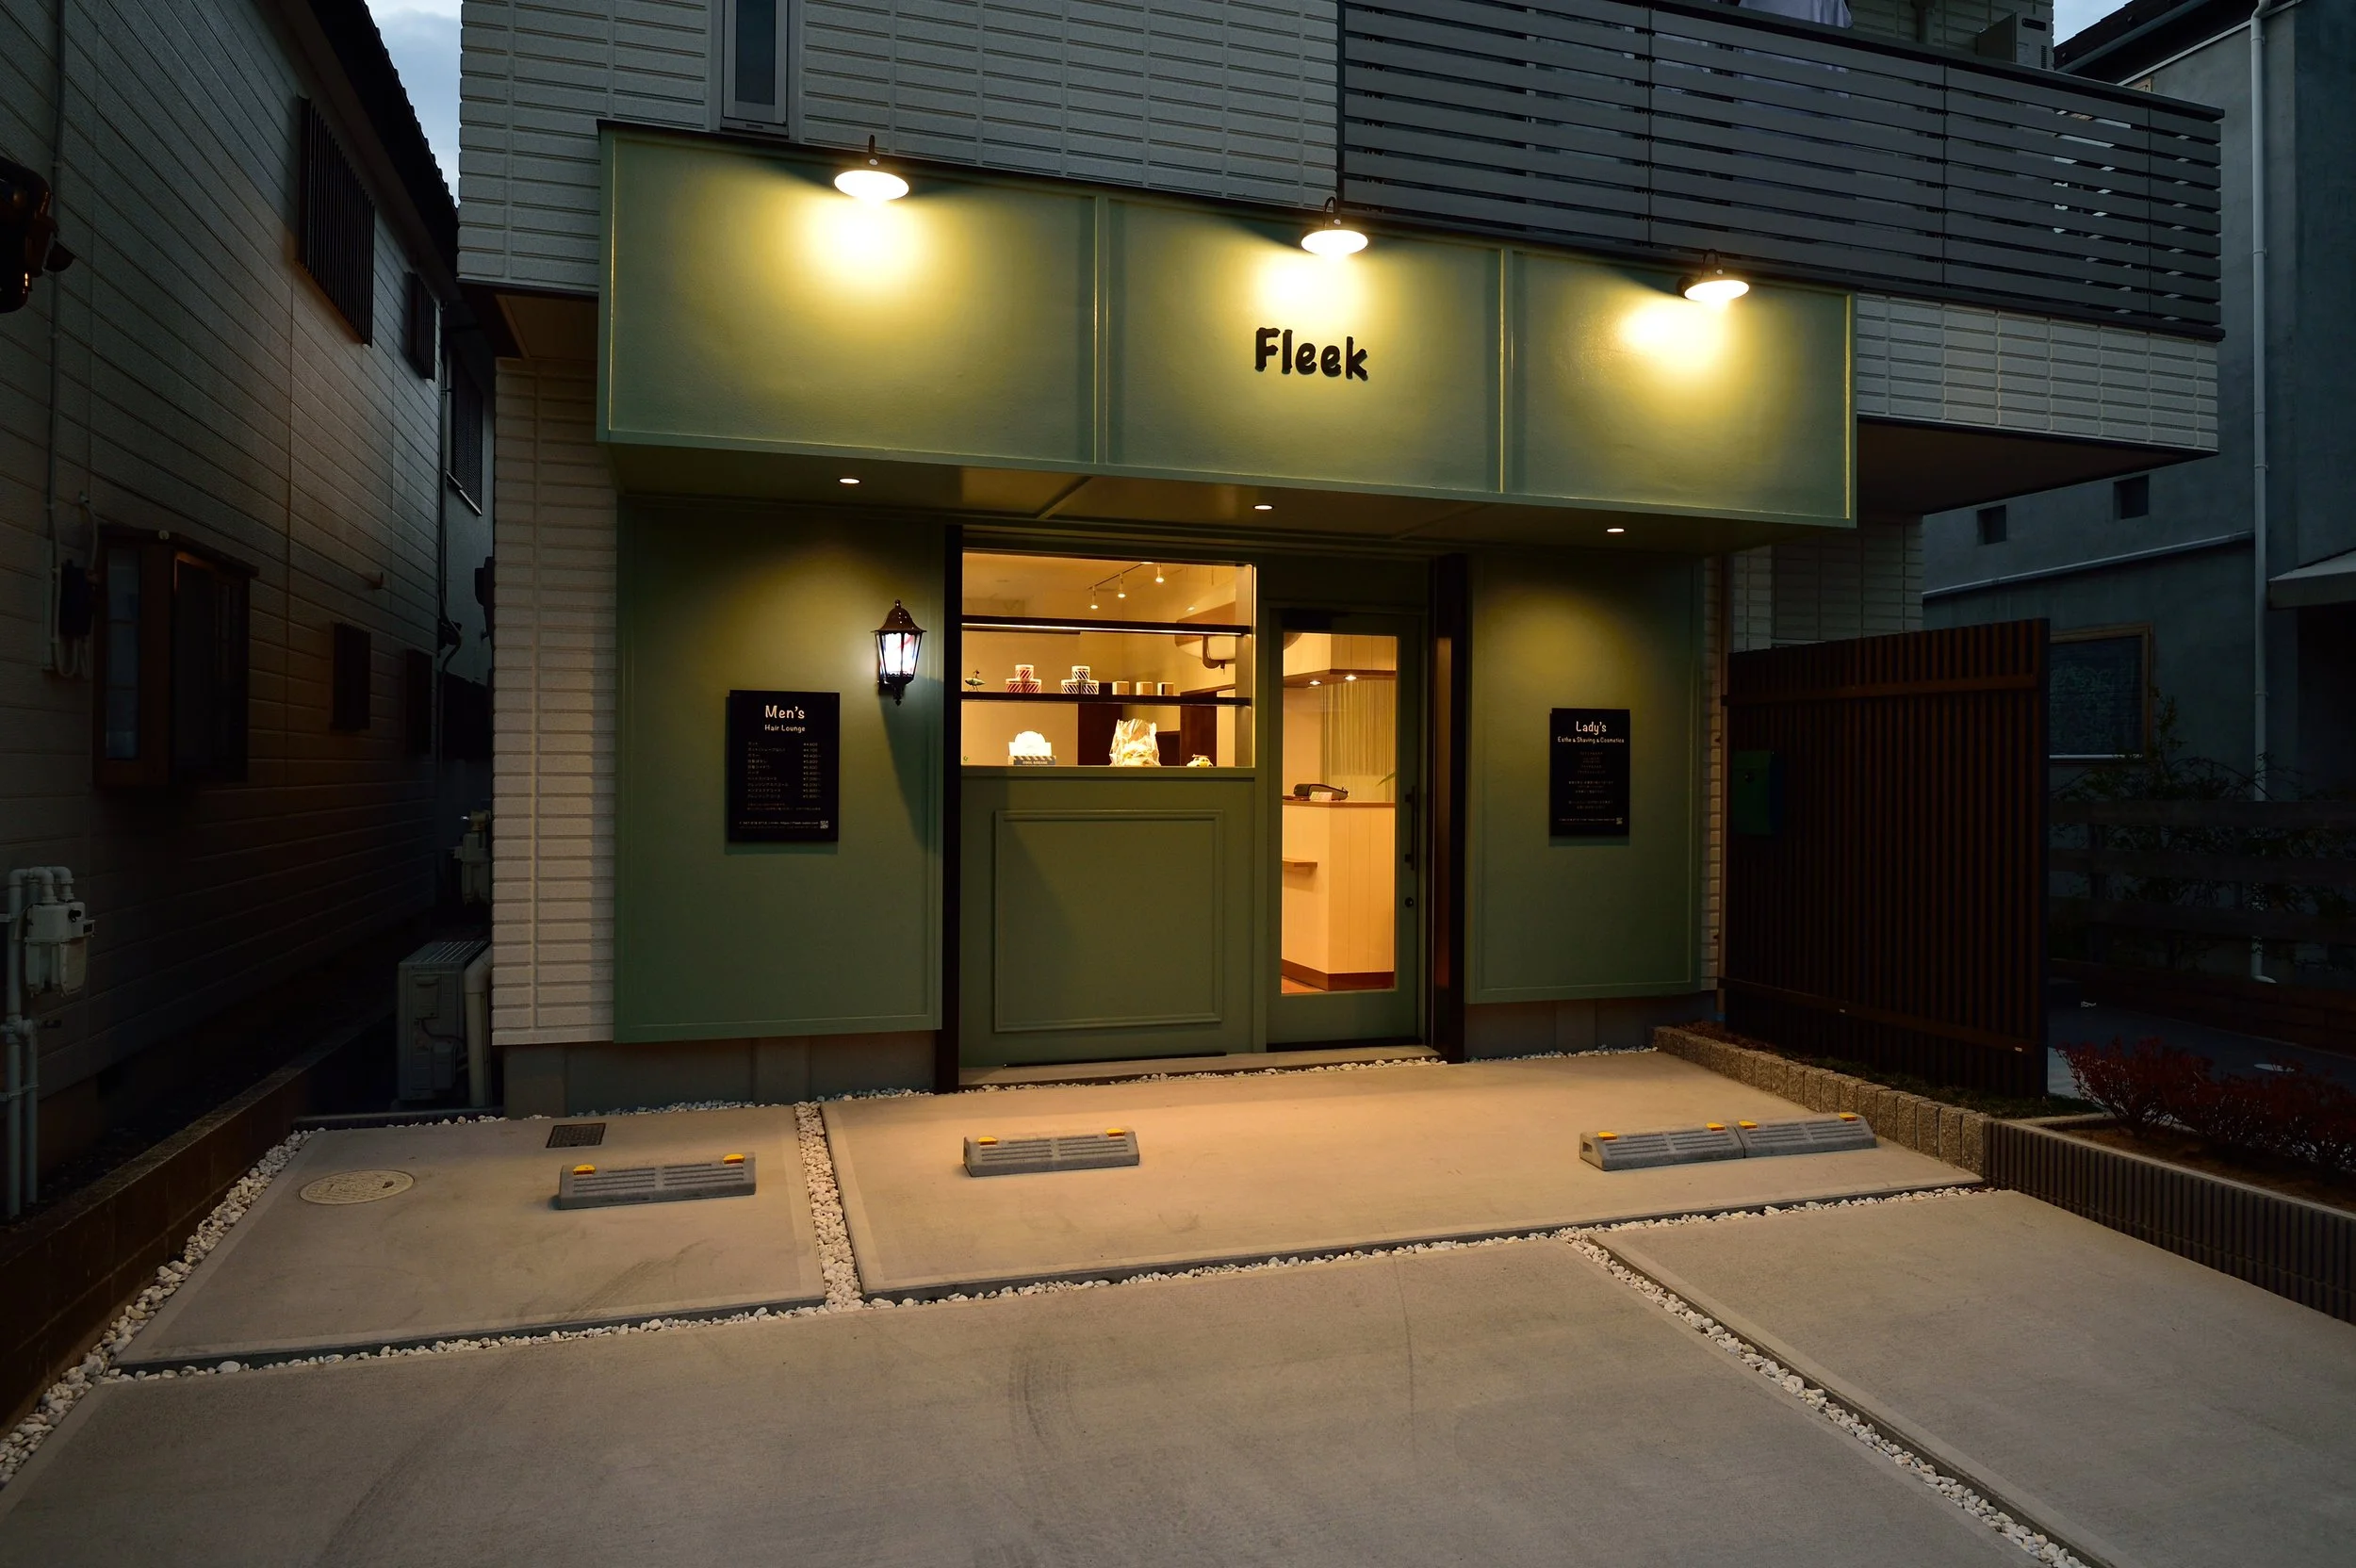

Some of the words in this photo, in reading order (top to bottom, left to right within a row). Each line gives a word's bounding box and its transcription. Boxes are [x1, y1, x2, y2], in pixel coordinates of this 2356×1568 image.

[1254, 327, 1368, 381] Fleek
[765, 705, 805, 719] Men's
[781, 725, 806, 733] Lounge
[1576, 721, 1607, 735] Lady's
